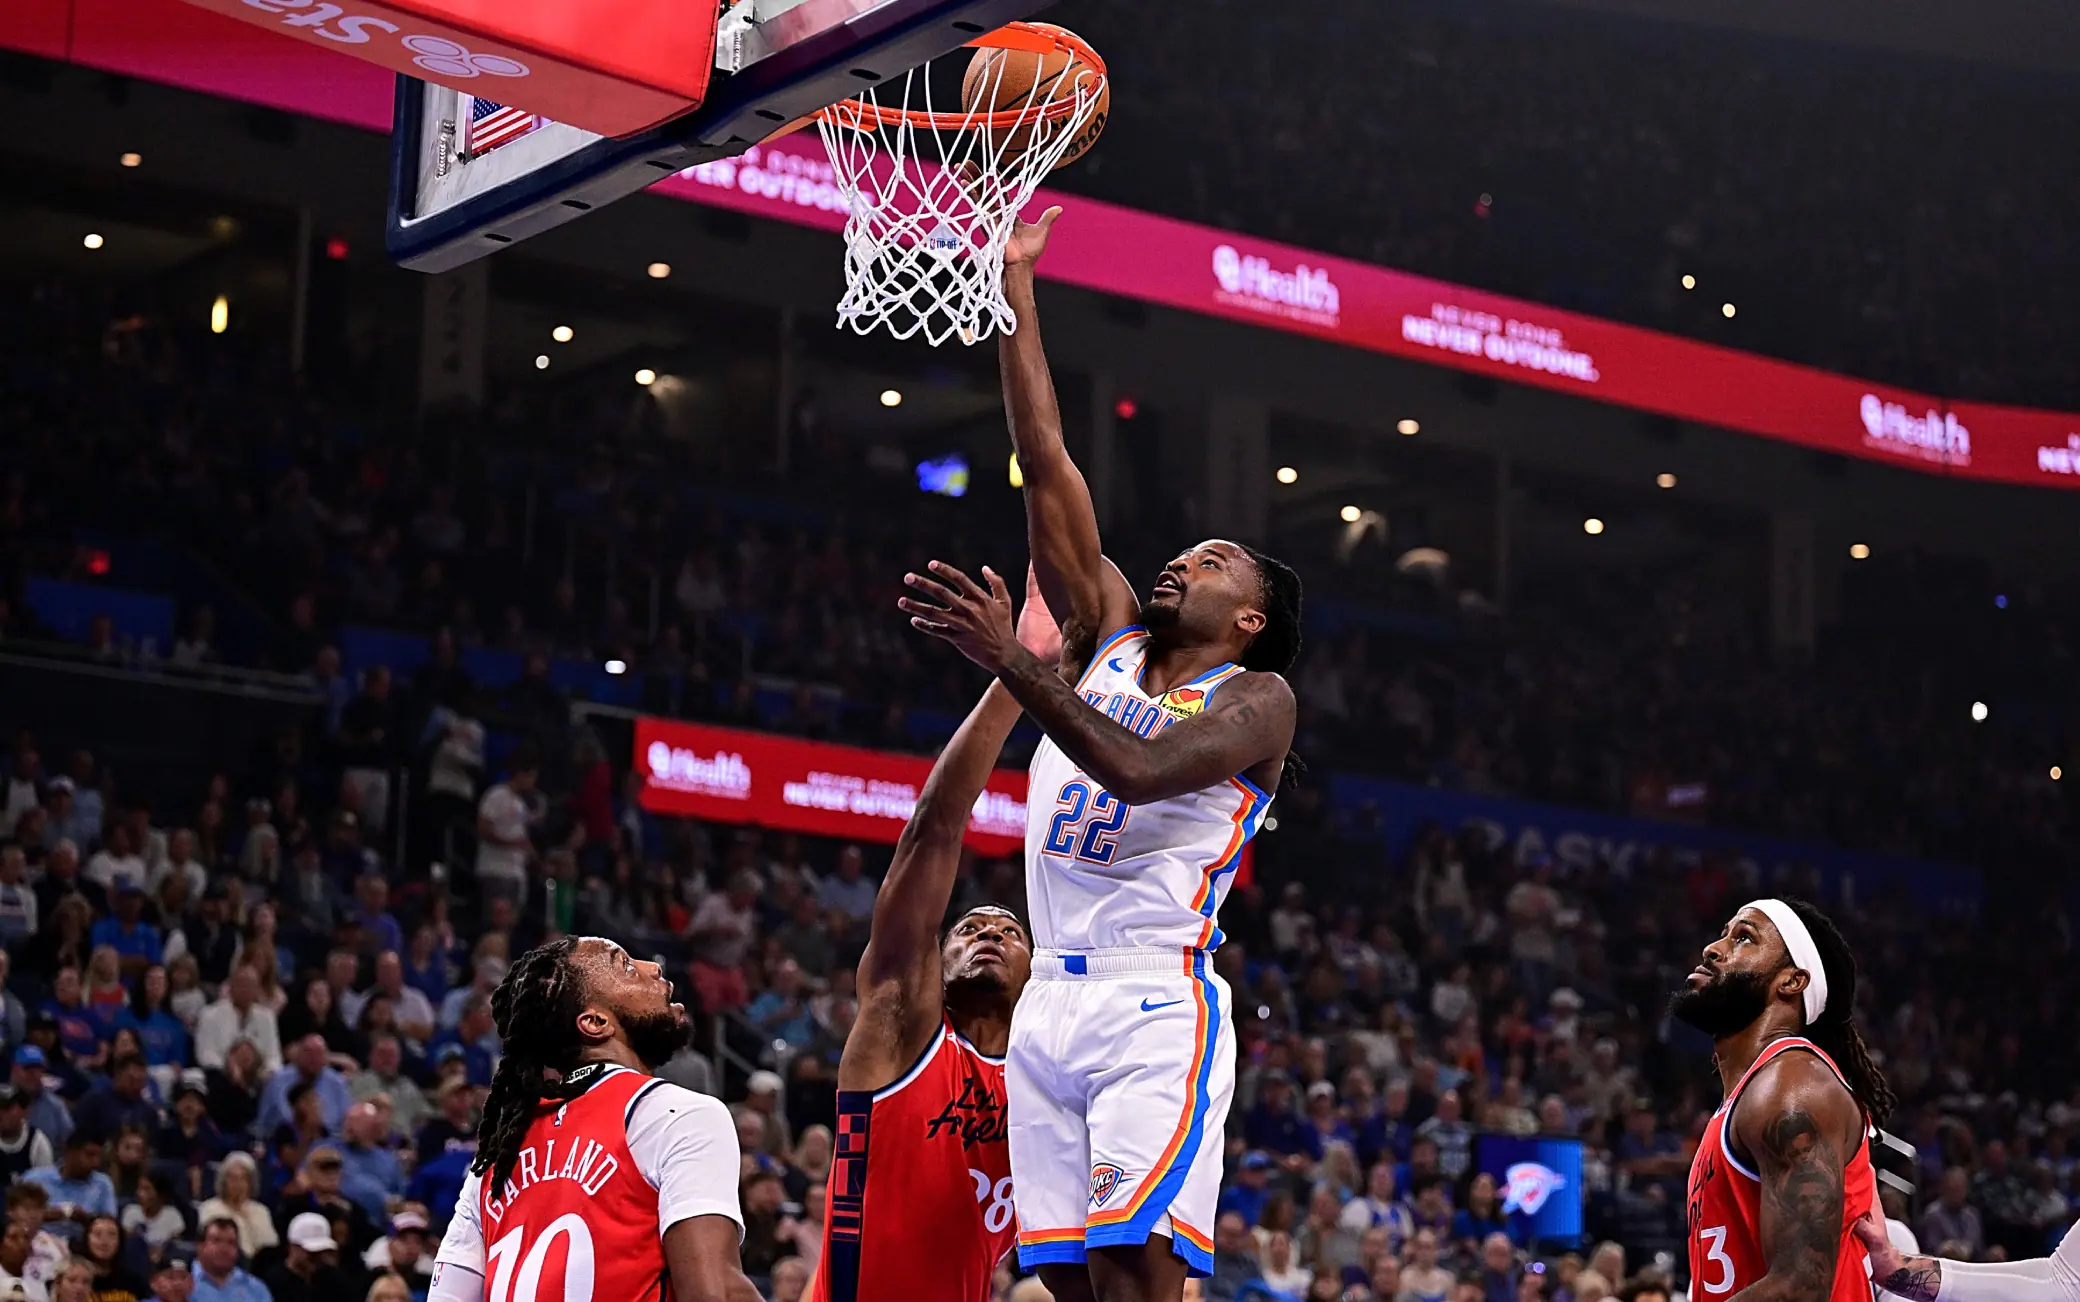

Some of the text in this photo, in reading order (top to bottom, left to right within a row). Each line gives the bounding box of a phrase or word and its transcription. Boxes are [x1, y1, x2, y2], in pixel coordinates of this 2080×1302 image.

[1402, 314, 1482, 357] NEVER
[1041, 780, 1131, 866] 22
[485, 1136, 618, 1224] GARLAND
[487, 1212, 595, 1302] 10
